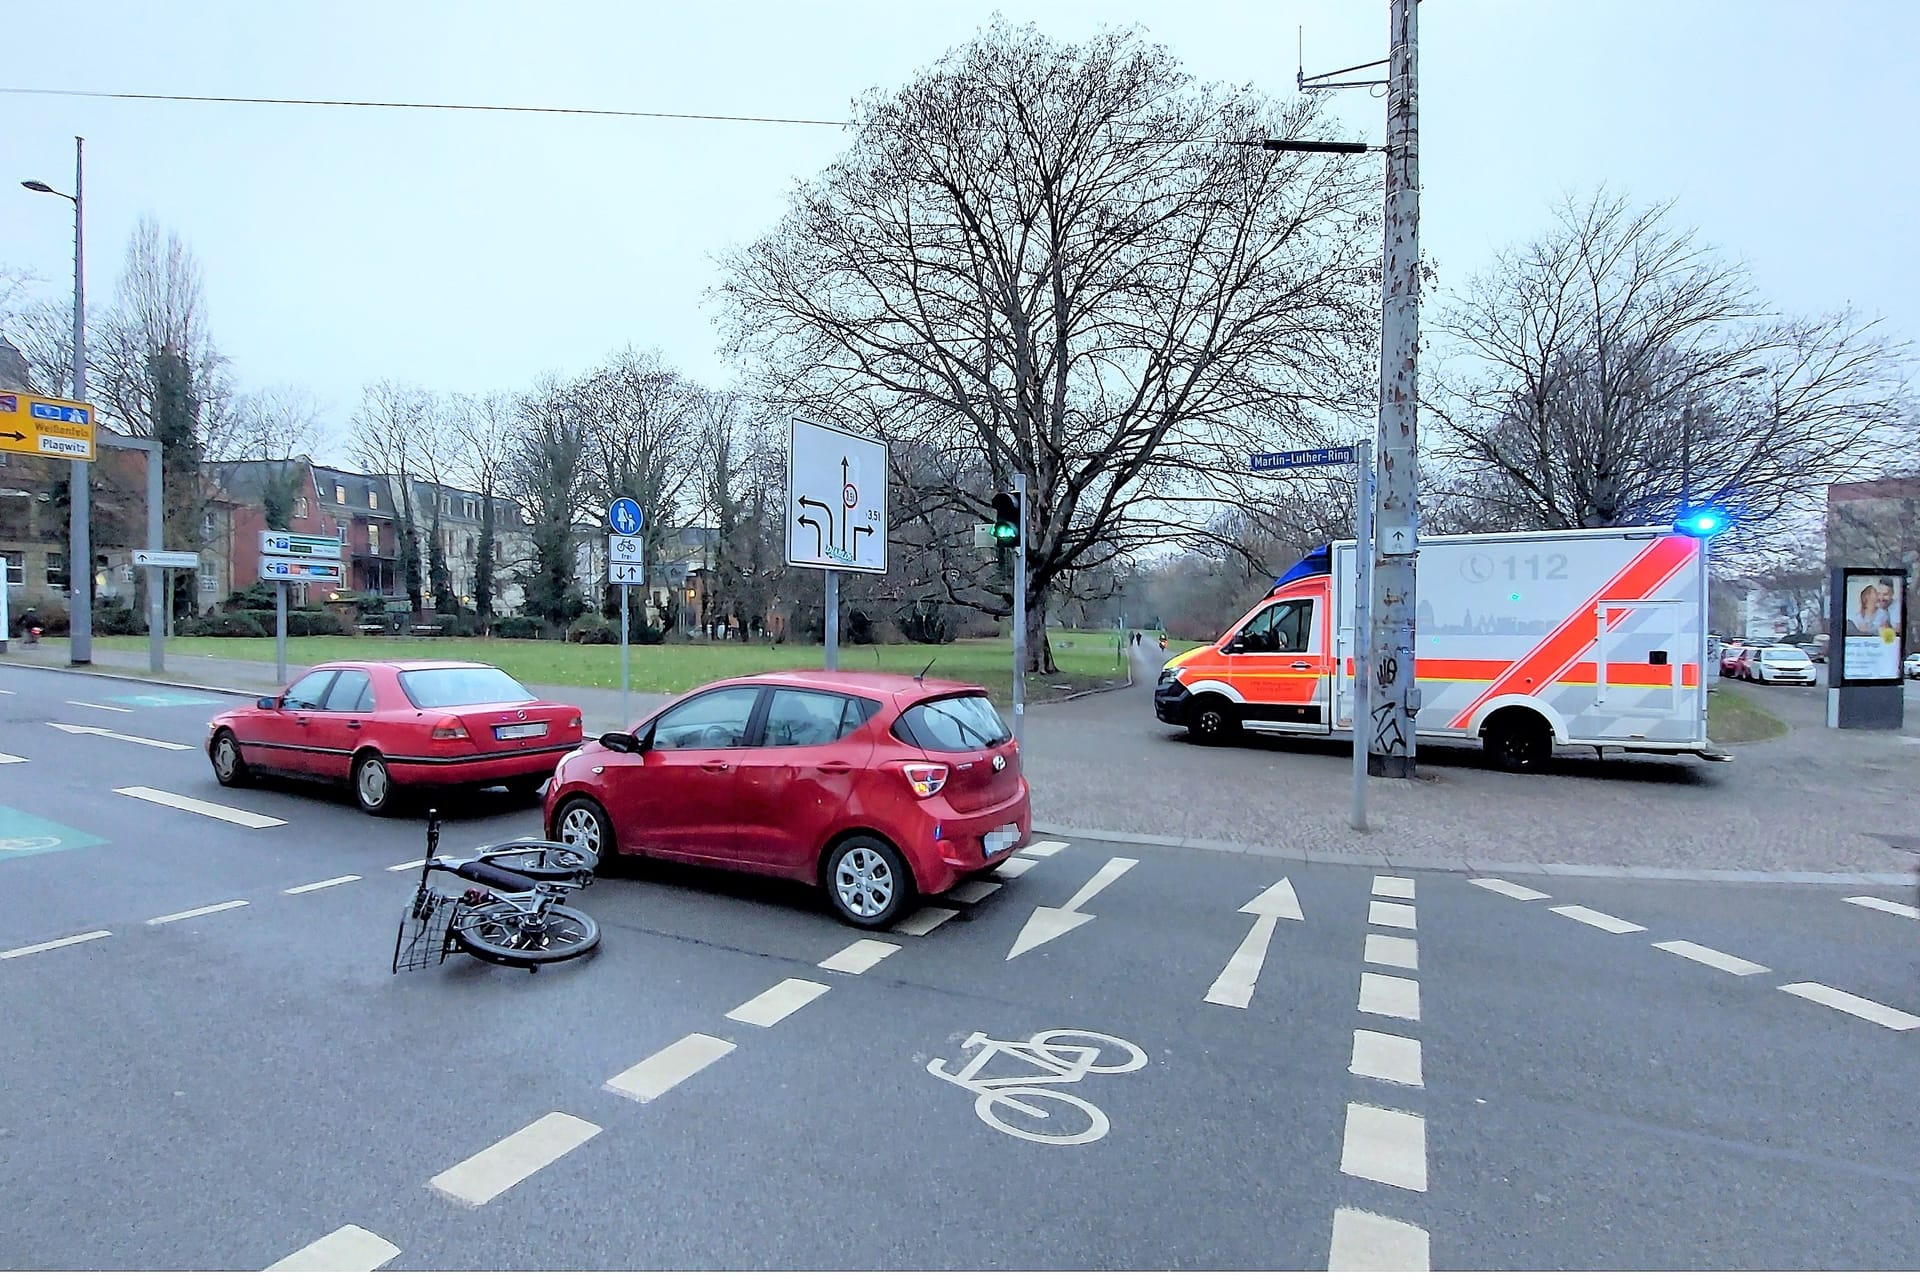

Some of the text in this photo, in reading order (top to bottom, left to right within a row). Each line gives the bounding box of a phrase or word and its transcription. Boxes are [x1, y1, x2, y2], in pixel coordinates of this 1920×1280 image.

[42, 438, 86, 453] Plagwitz
[1254, 449, 1350, 468] Martin-Luther-Ring
[1501, 553, 1569, 580] 112
